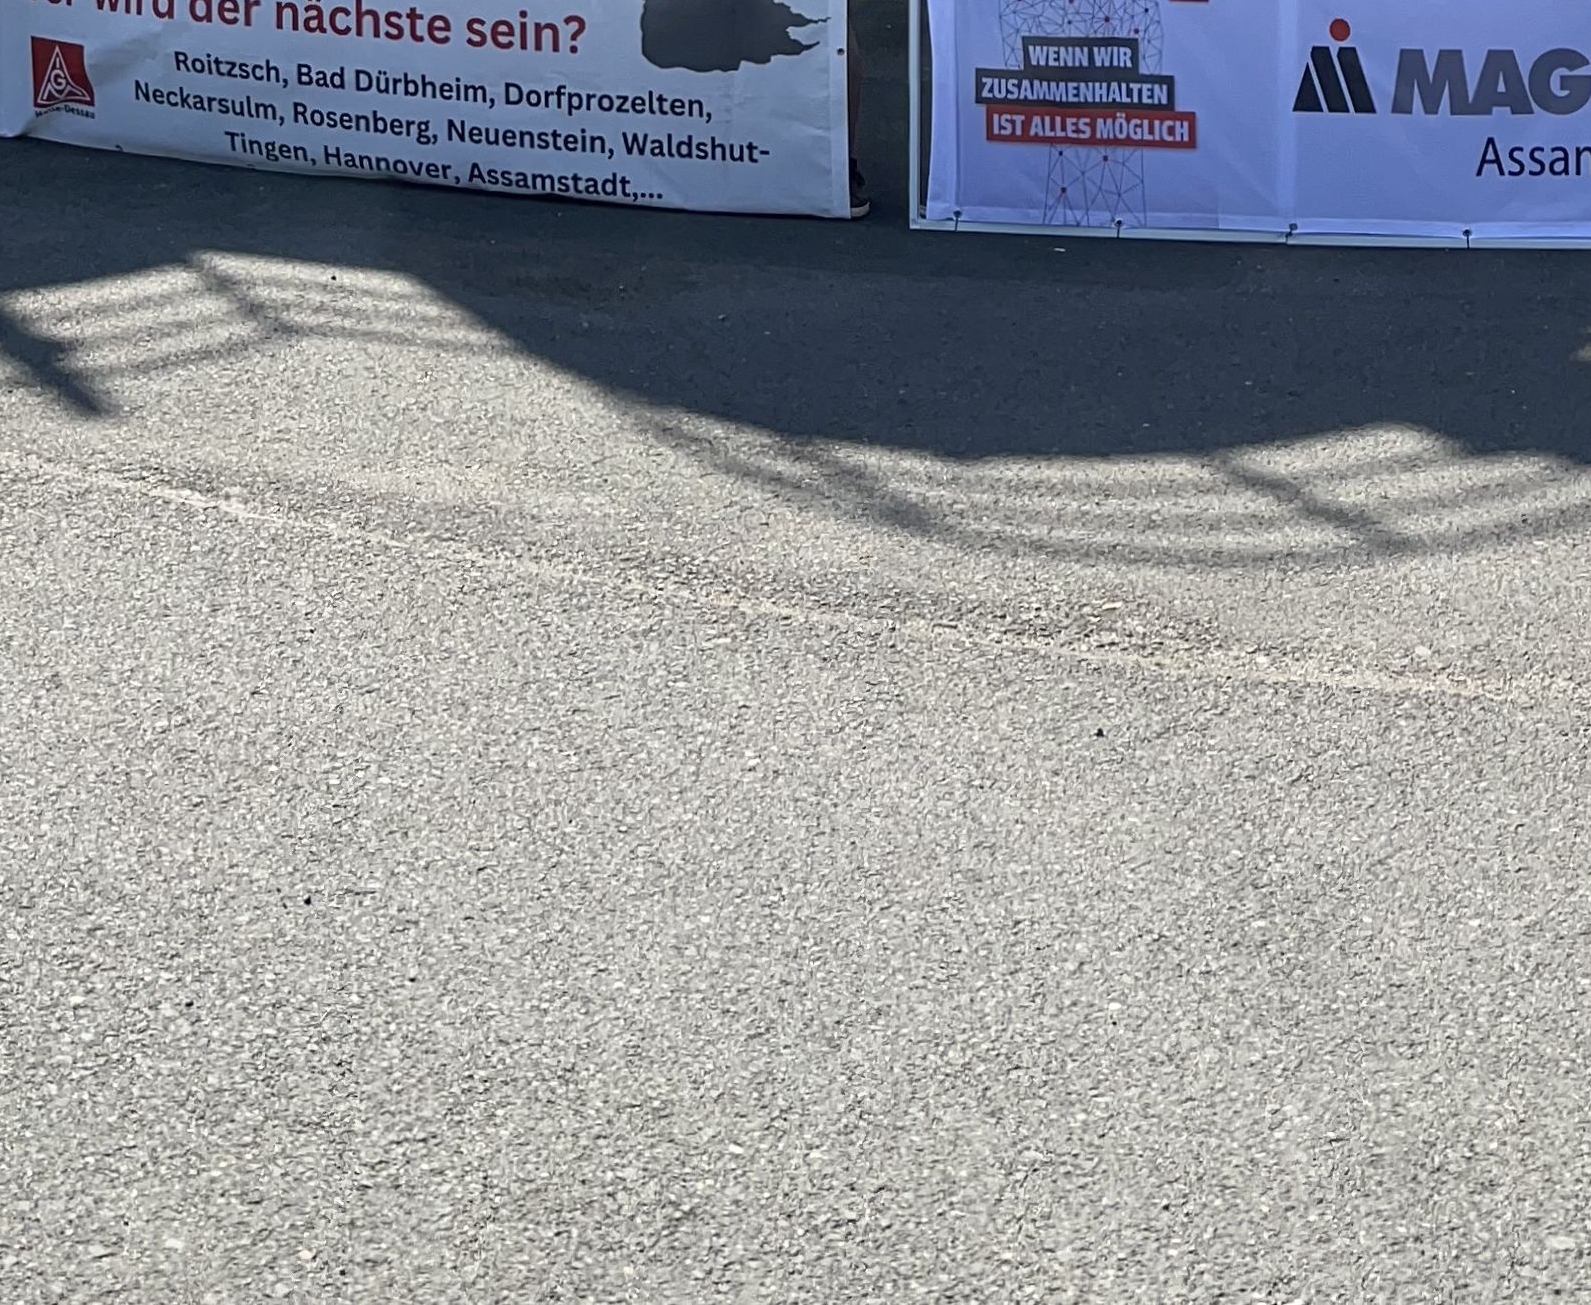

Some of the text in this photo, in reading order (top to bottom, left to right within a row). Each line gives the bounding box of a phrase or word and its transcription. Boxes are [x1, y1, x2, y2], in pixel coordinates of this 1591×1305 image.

[466, 9, 587, 54] sein?
[1028, 44, 1133, 69] WENN WIR
[174, 50, 714, 124] Roitzsch, Bad Dürbheim, Dorfprozelten,
[980, 77, 1169, 106] ZUSAMMENHALTEN
[133, 80, 772, 165] Neckarsulm, Rosenberg, Neuenstein, Waldshut-
[992, 111, 1190, 143] IST ALLES MÖGLICH
[224, 130, 665, 203] Tingen, Hannover, Assamstadt,...
